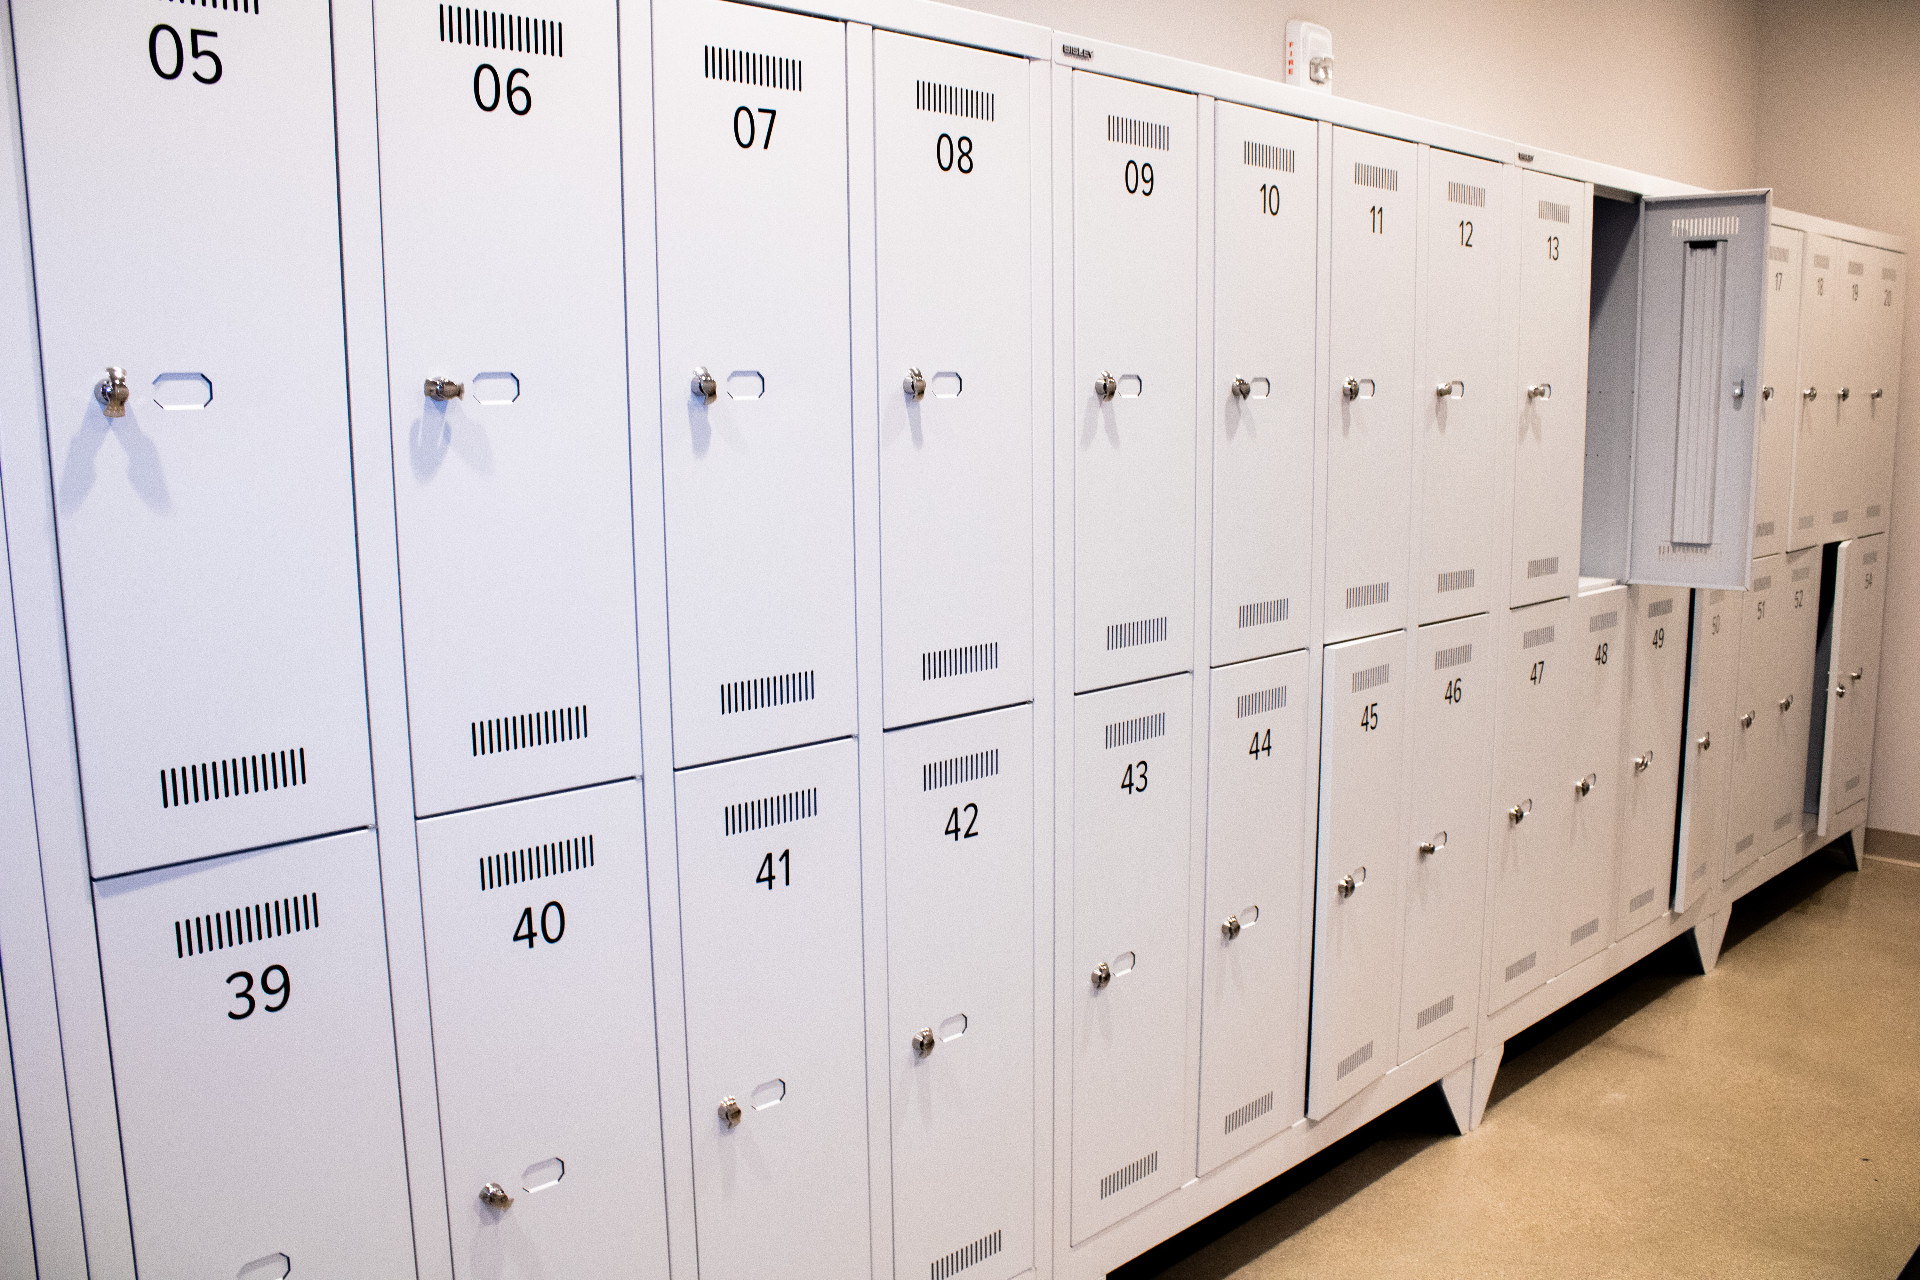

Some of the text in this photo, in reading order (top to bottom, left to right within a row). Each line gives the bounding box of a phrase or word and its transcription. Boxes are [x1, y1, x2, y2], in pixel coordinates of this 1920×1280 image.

[148, 23, 223, 85] 05
[473, 63, 532, 116] 06
[733, 105, 777, 150] 07
[936, 132, 974, 175] 08
[1124, 159, 1155, 197] 09
[1259, 183, 1281, 217] 10
[1369, 205, 1384, 234] 11
[1459, 220, 1474, 248] 12
[1547, 235, 1560, 262] 13
[1774, 271, 1784, 291] 17
[1816, 277, 1825, 297] 18
[1851, 283, 1859, 302] 19
[1883, 288, 1893, 308] 20
[1864, 572, 1874, 591] 54
[1756, 600, 1766, 621] 51
[1794, 589, 1804, 609] 52
[1651, 627, 1665, 649] 49
[1711, 614, 1721, 636] 50
[1594, 642, 1609, 665] 48
[1529, 660, 1545, 685] 47
[1444, 677, 1462, 704] 46
[1360, 702, 1379, 732] 45
[1248, 728, 1272, 760] 44
[1120, 760, 1148, 795] 43
[944, 802, 979, 842] 42
[755, 848, 790, 891] 41
[512, 900, 566, 949] 40
[225, 964, 291, 1021] 39
